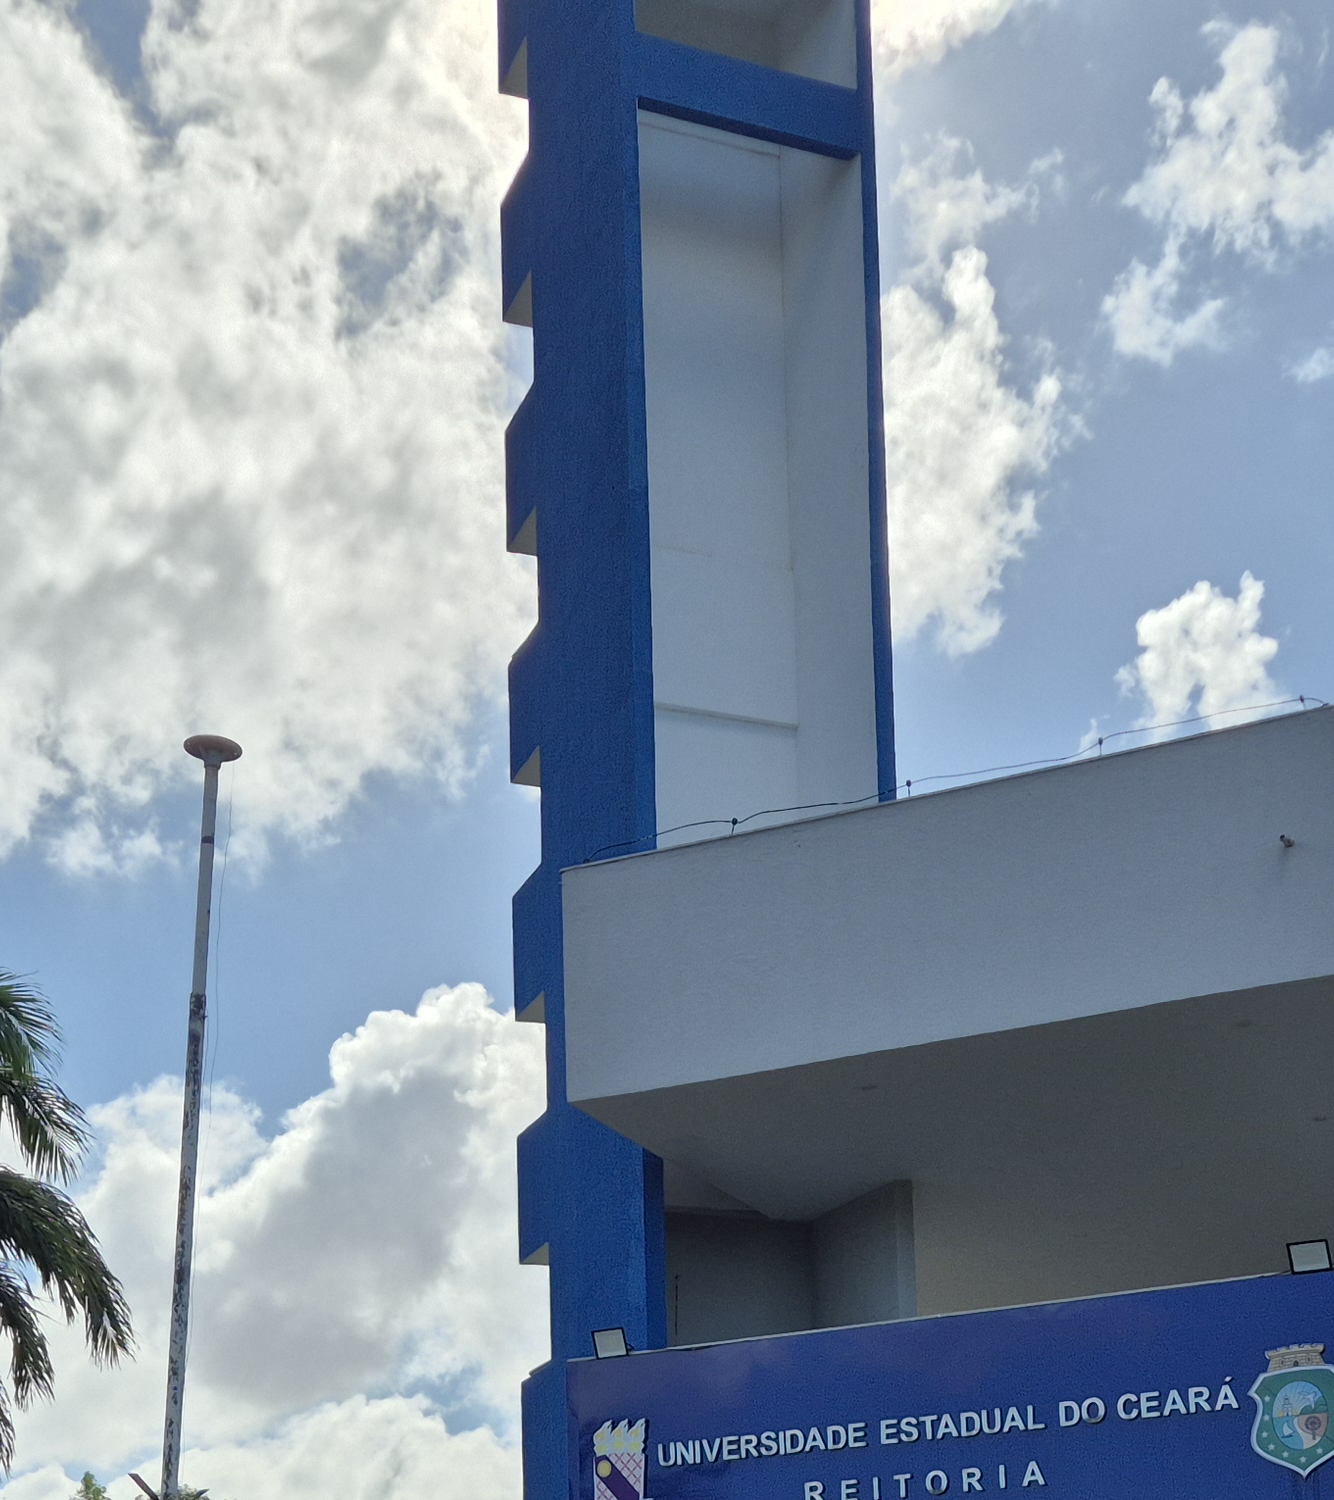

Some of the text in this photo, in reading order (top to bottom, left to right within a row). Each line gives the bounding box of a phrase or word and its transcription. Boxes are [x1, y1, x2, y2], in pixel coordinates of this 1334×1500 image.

[657, 1376, 1240, 1467] UNIVERSIDADE ESTADUAL DO CEARÁ
